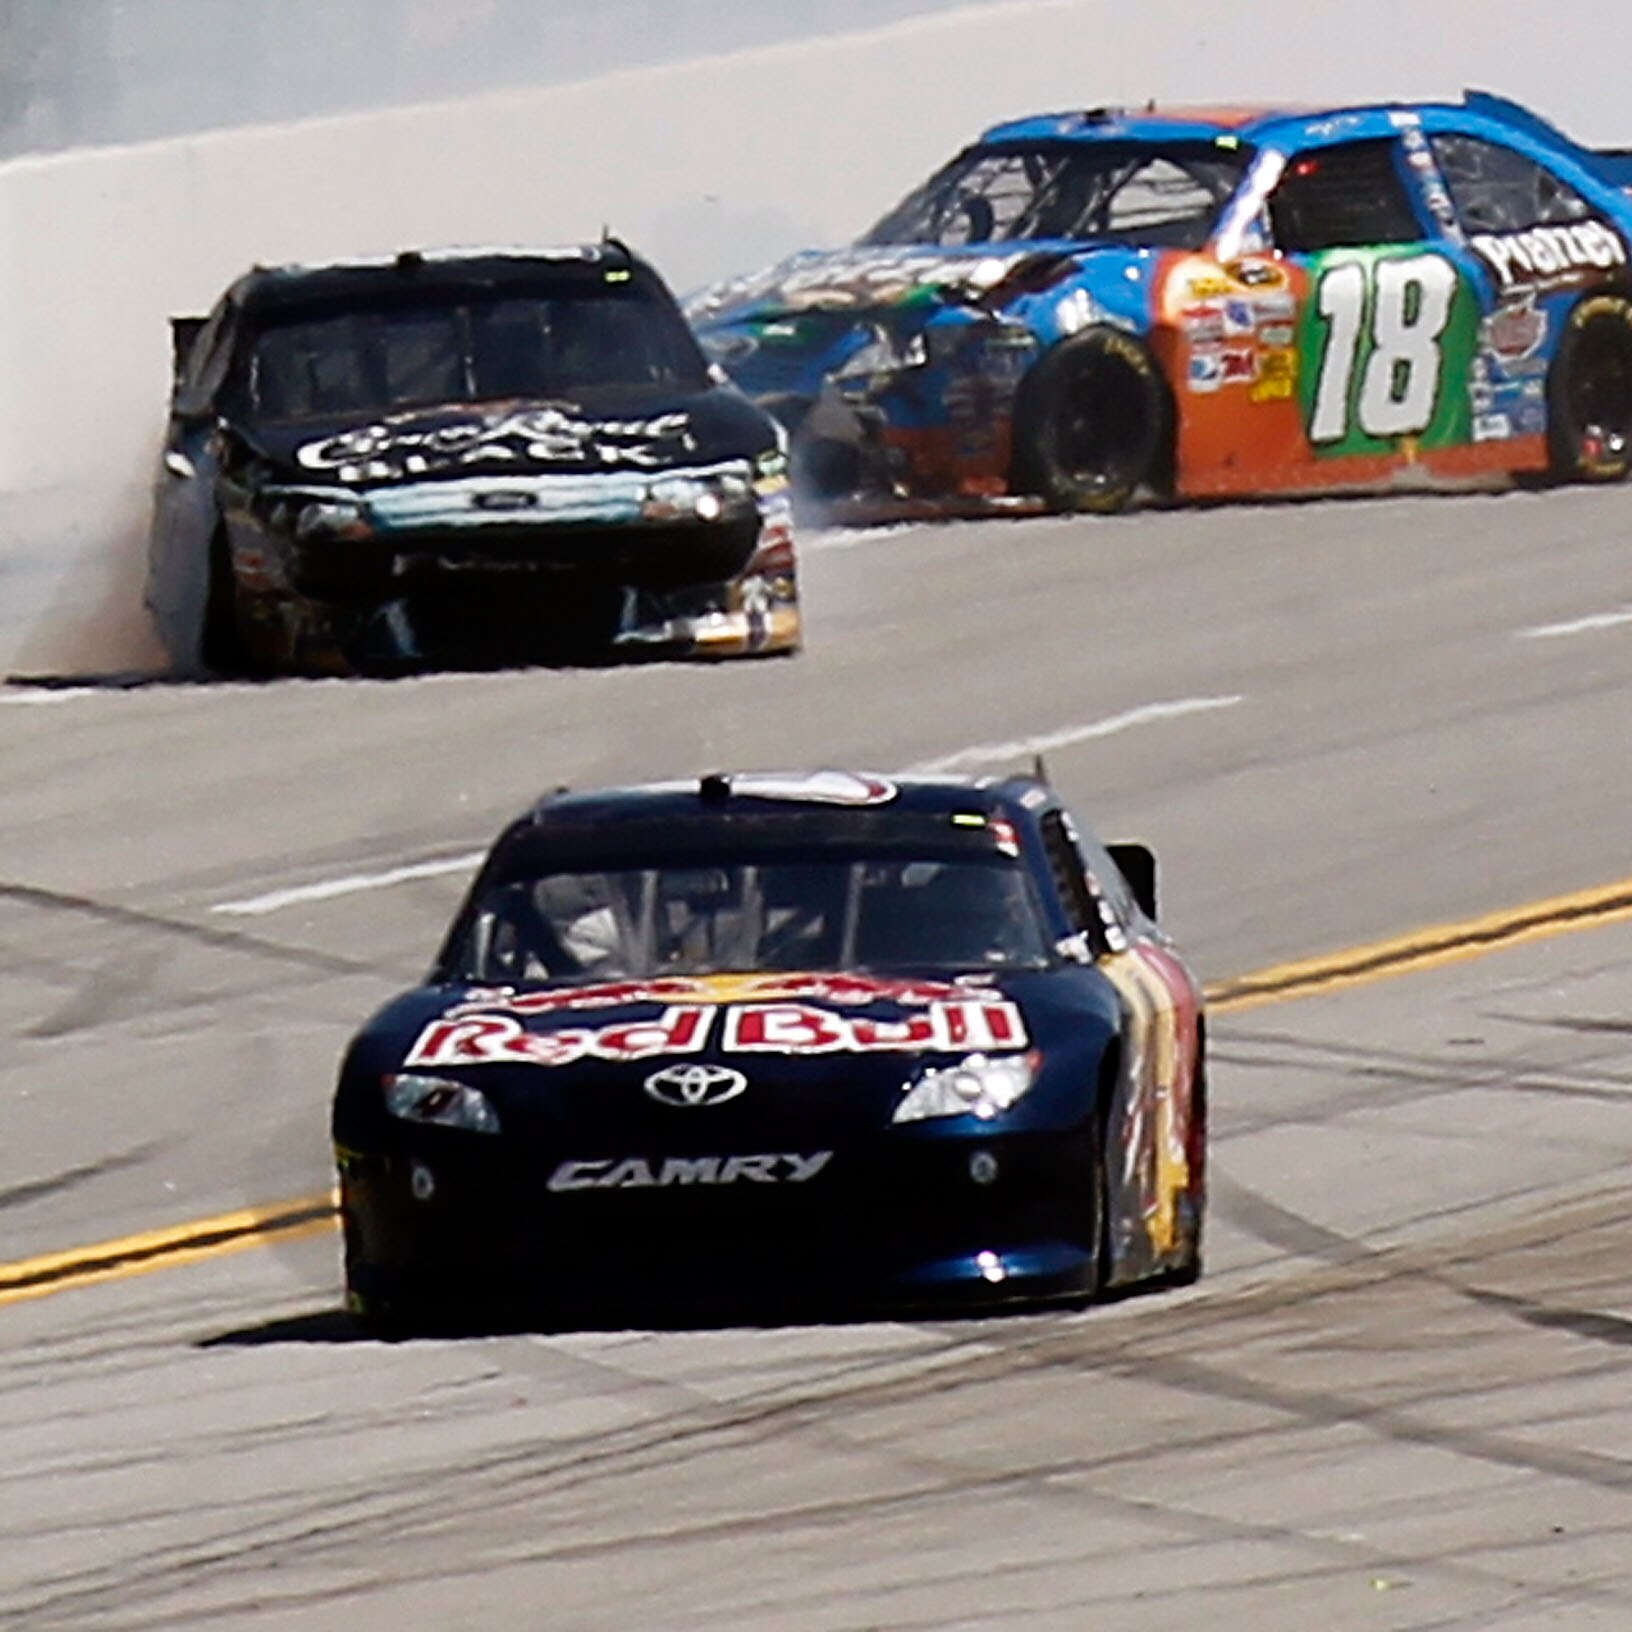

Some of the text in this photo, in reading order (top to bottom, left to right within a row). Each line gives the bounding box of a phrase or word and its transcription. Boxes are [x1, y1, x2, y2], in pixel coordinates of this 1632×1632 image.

[1309, 254, 1458, 444] 18
[404, 1000, 1030, 1067] Red Bull
[546, 1150, 834, 1192] CAMRY
